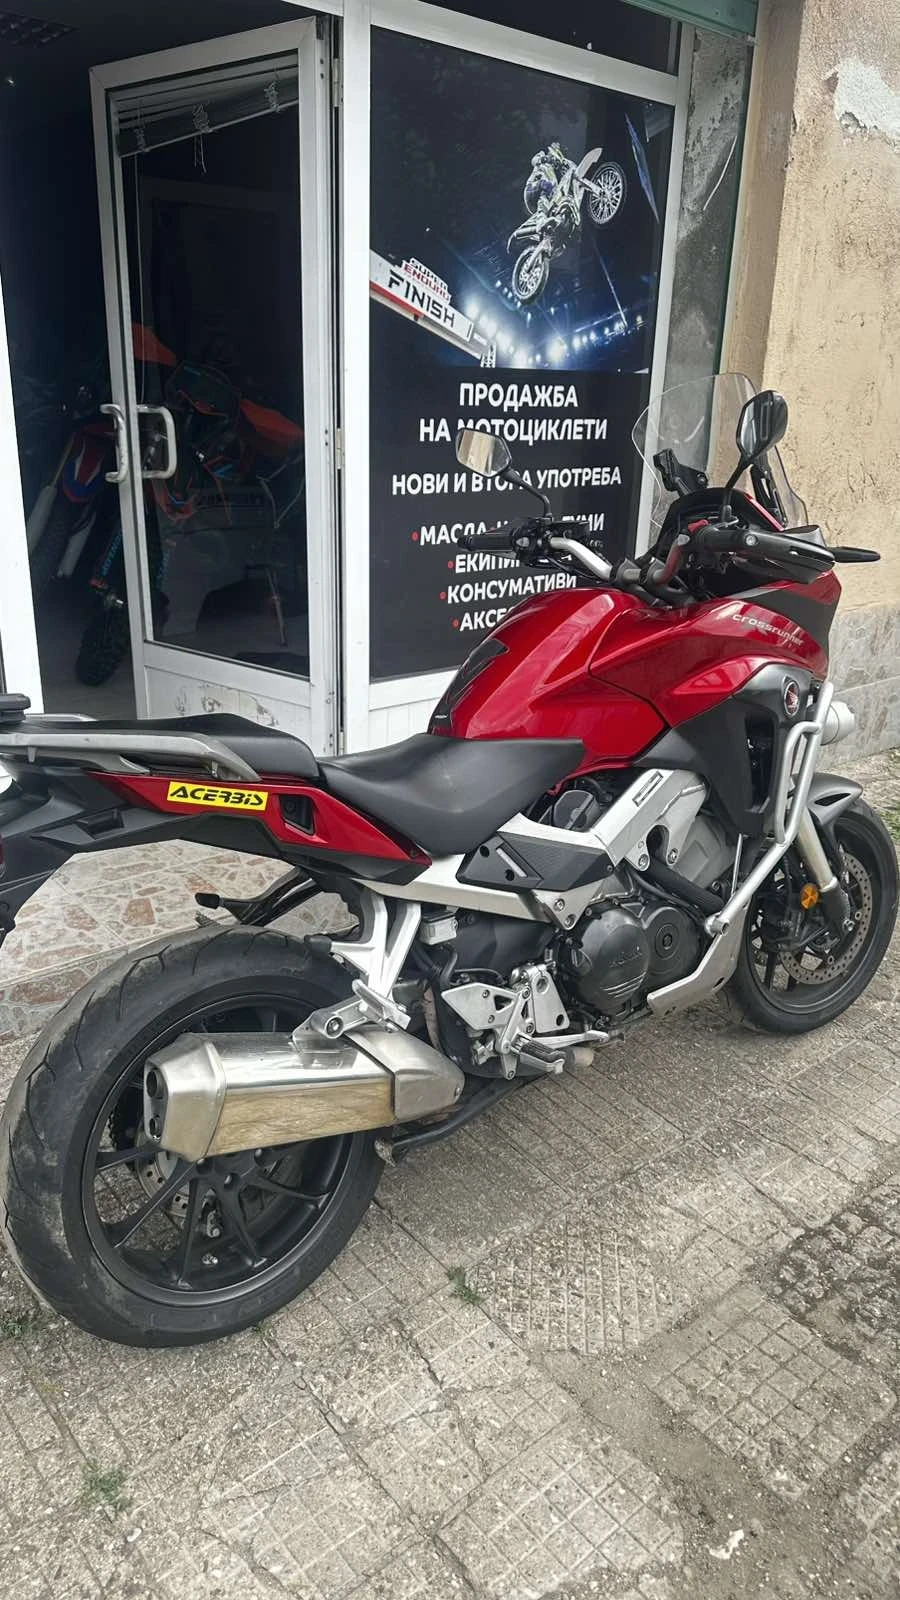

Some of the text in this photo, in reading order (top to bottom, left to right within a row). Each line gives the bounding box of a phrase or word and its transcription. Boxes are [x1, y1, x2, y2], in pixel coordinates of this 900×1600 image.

[404, 263, 450, 301] ENDURO
[388, 269, 455, 328] FINISH
[459, 382, 578, 412] ПРОДАЖБА
[419, 418, 451, 442] НА
[392, 472, 449, 495] НОВИ
[454, 472, 467, 493] И
[536, 466, 622, 489] УПОТРЕБА
[420, 521, 487, 546] МАСЛА
[447, 573, 577, 604] КОНСУМАТИВИ
[732, 613, 804, 647] crossrunner
